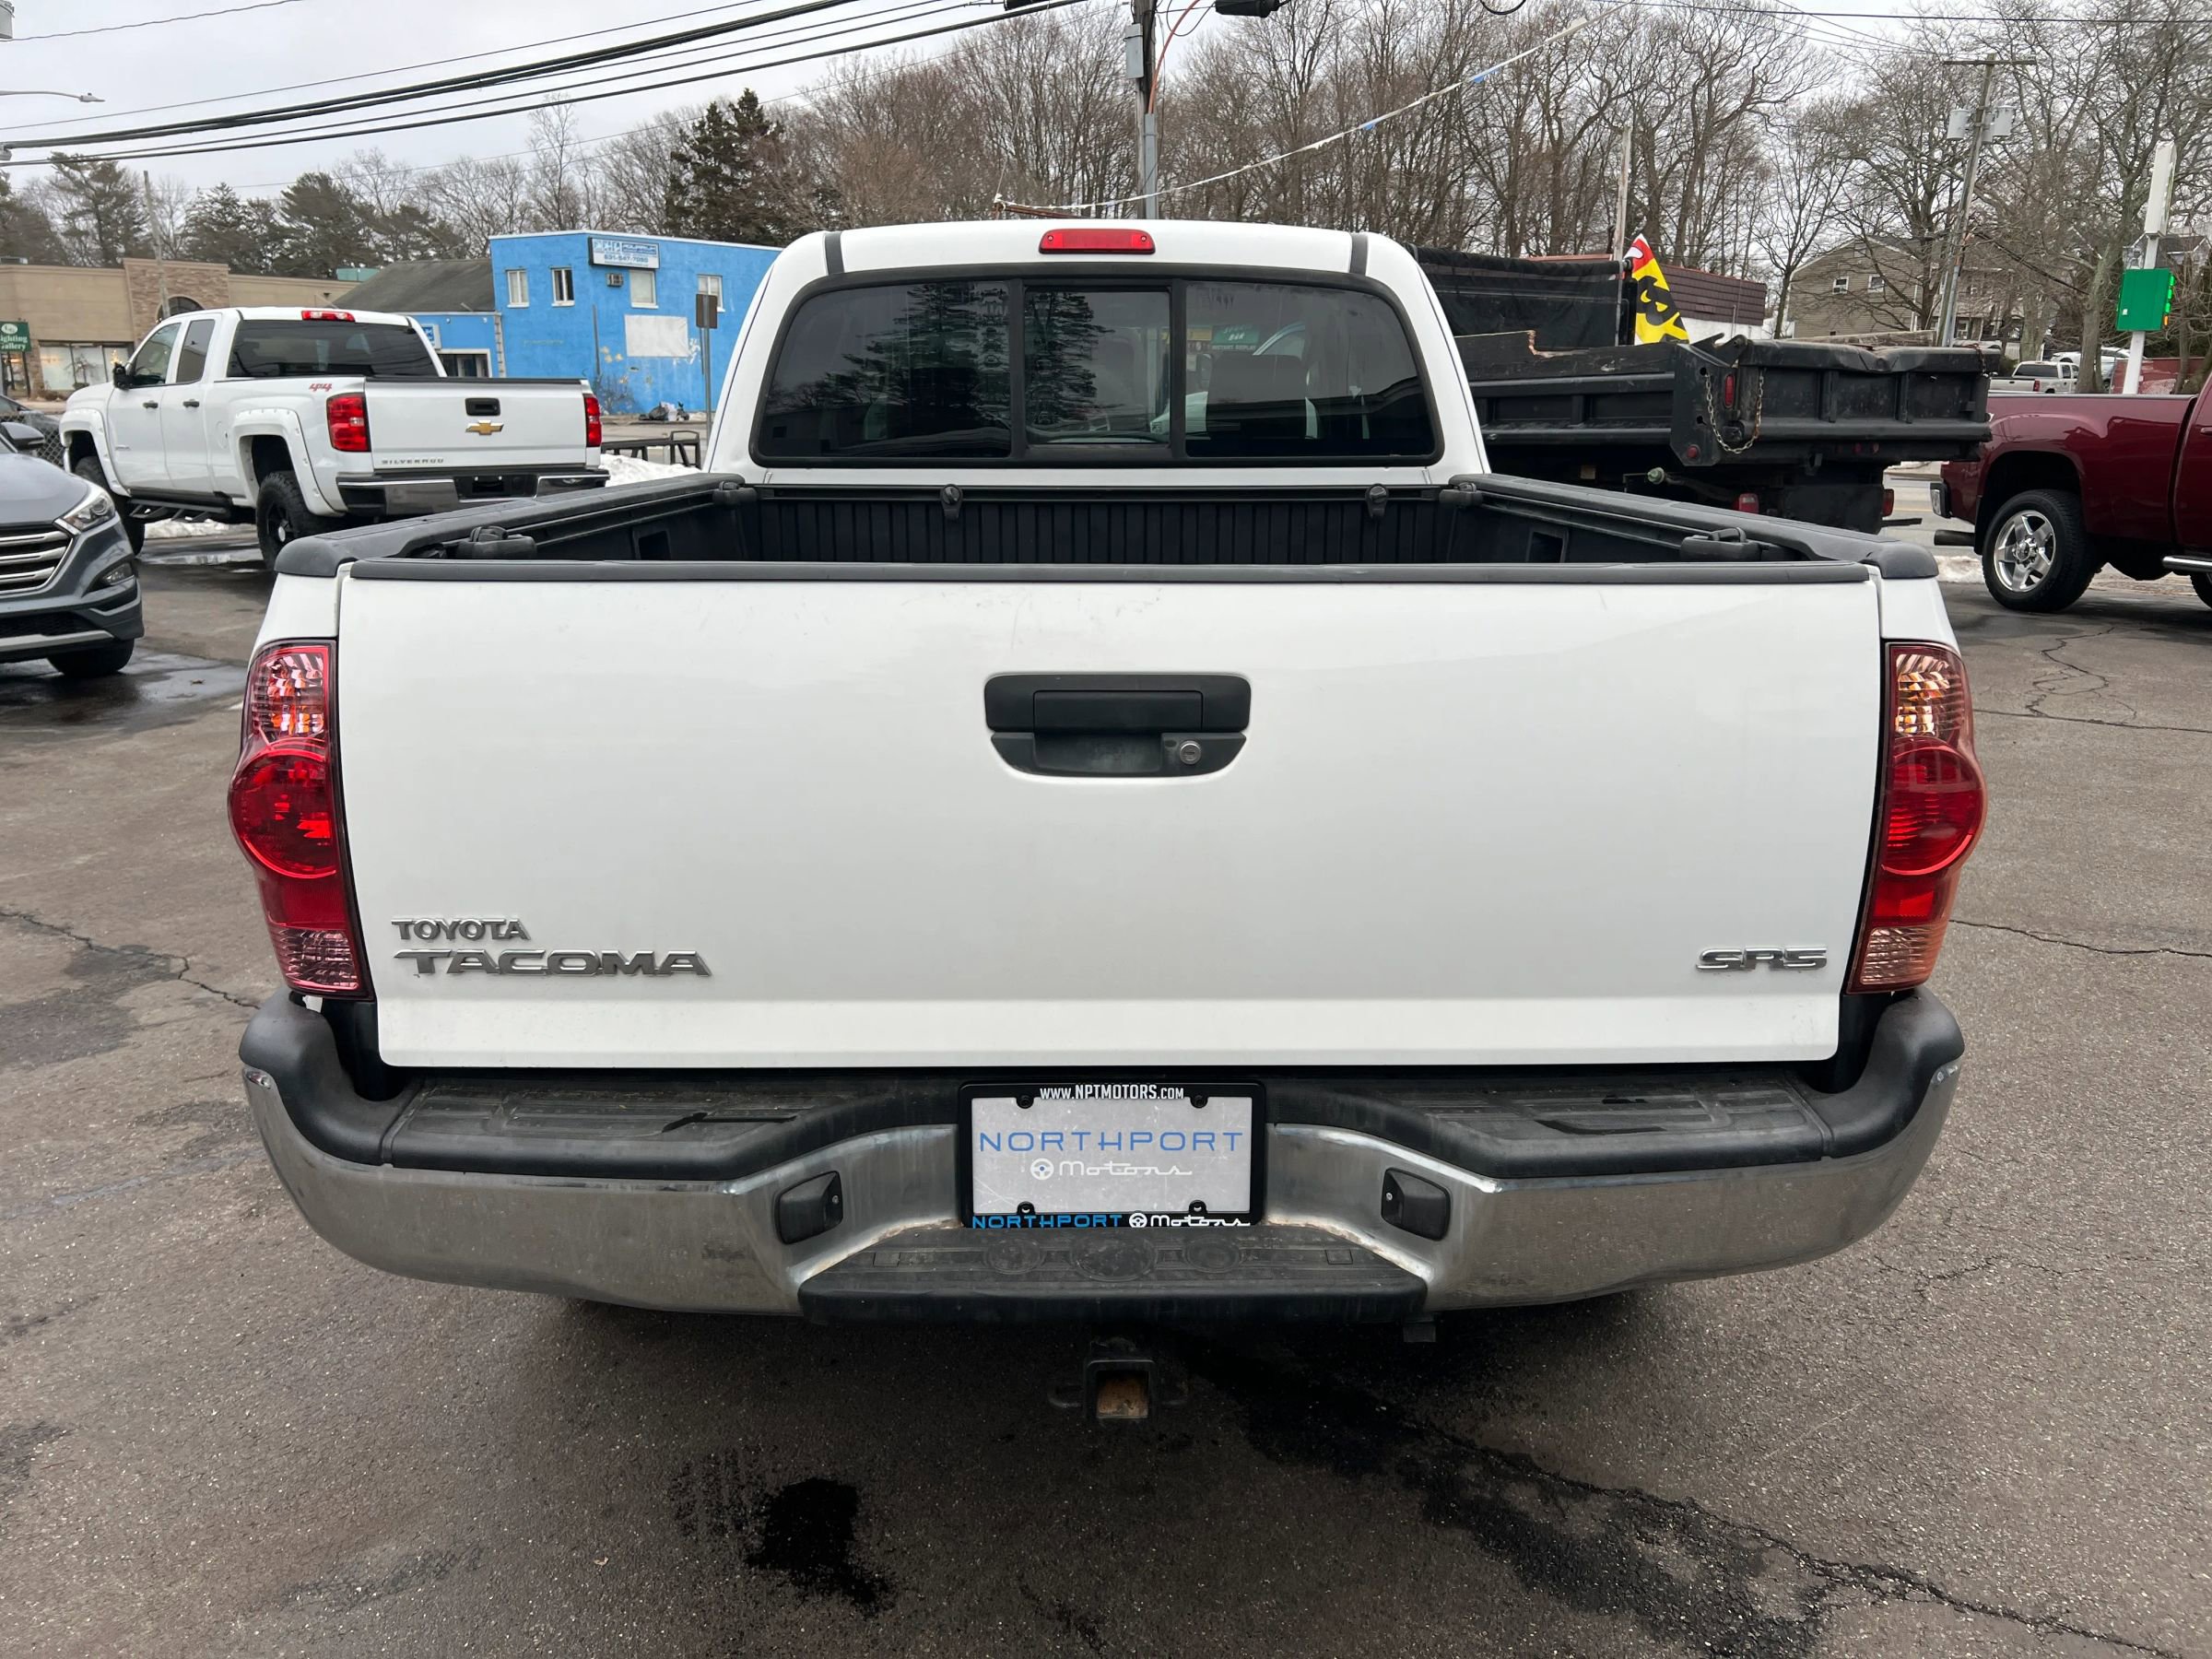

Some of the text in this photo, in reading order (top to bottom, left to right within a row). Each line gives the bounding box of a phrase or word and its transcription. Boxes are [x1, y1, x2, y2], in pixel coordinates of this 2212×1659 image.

[0, 335, 28, 344] ighting
[391, 918, 531, 940] TOYOTA
[394, 949, 712, 976] TACOMA
[1040, 1084, 1184, 1100] WWW.NPTMOTORS.COM
[980, 1132, 1243, 1151] NORTHPORT
[1059, 1160, 1193, 1176] Motors
[972, 1214, 1251, 1229] NORTHPORT Motors
